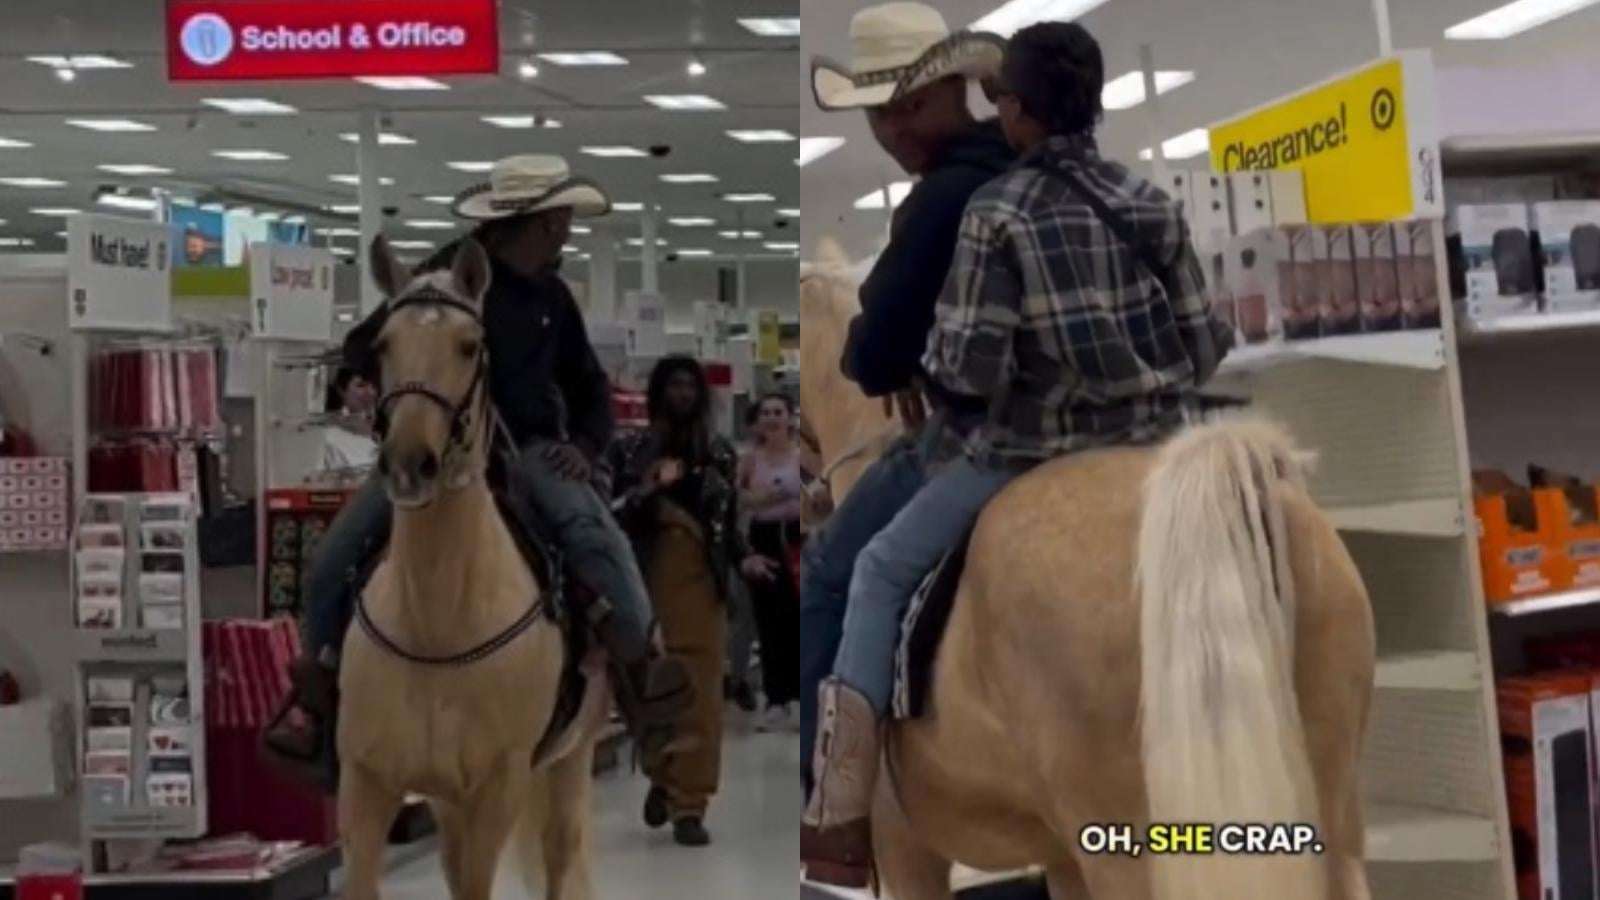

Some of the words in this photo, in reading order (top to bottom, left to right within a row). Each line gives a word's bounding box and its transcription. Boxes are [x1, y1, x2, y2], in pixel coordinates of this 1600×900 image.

[240, 25, 341, 50] School
[349, 23, 370, 48] &
[377, 22, 466, 47] Office
[1223, 101, 1348, 173] Clearance!
